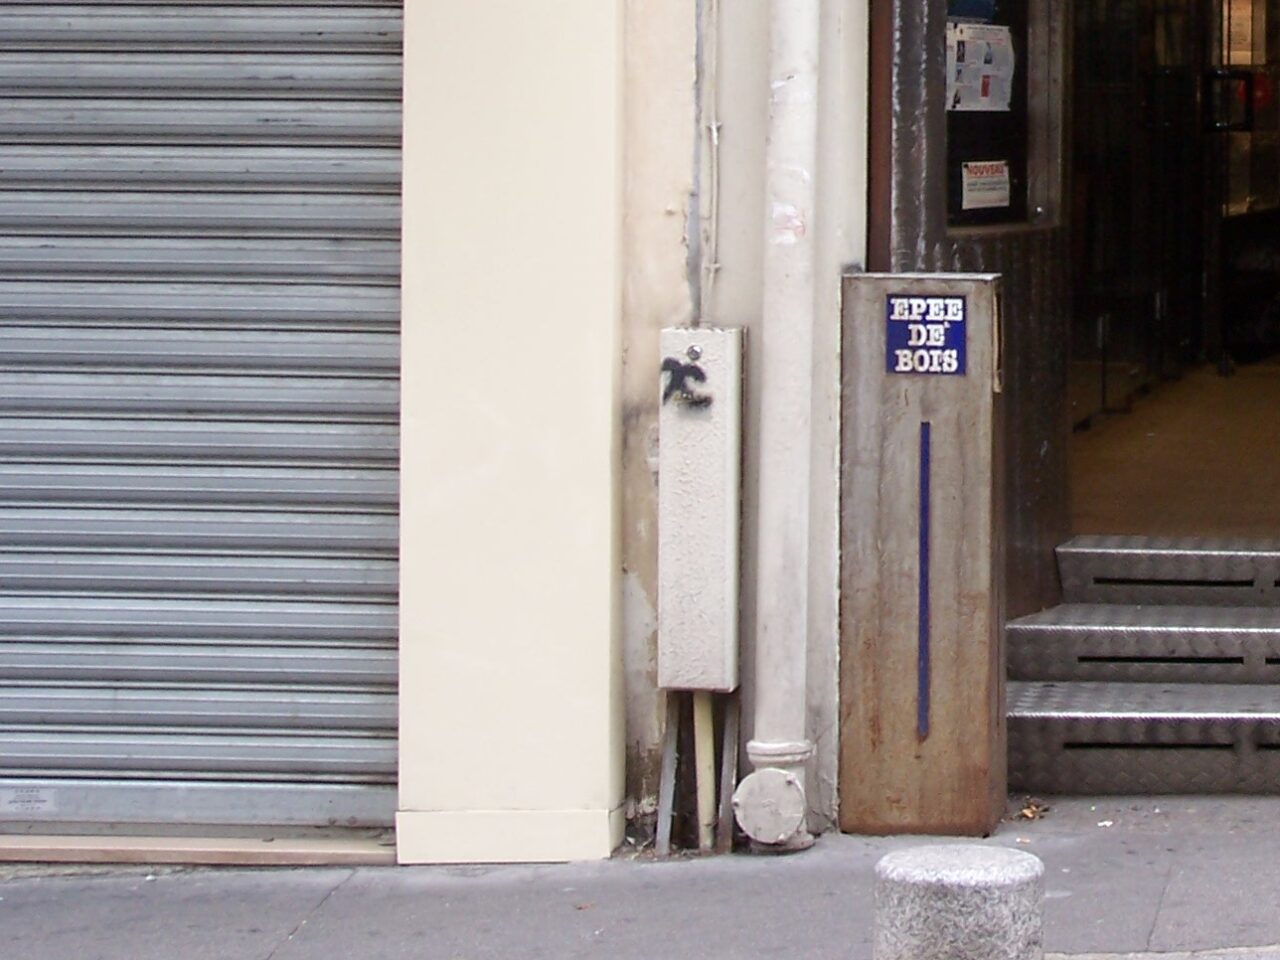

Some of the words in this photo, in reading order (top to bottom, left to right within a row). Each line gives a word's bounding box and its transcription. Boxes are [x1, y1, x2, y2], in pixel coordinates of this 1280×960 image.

[889, 298, 964, 321] EPEE
[907, 323, 945, 346] DE
[894, 348, 959, 373] BOIS
